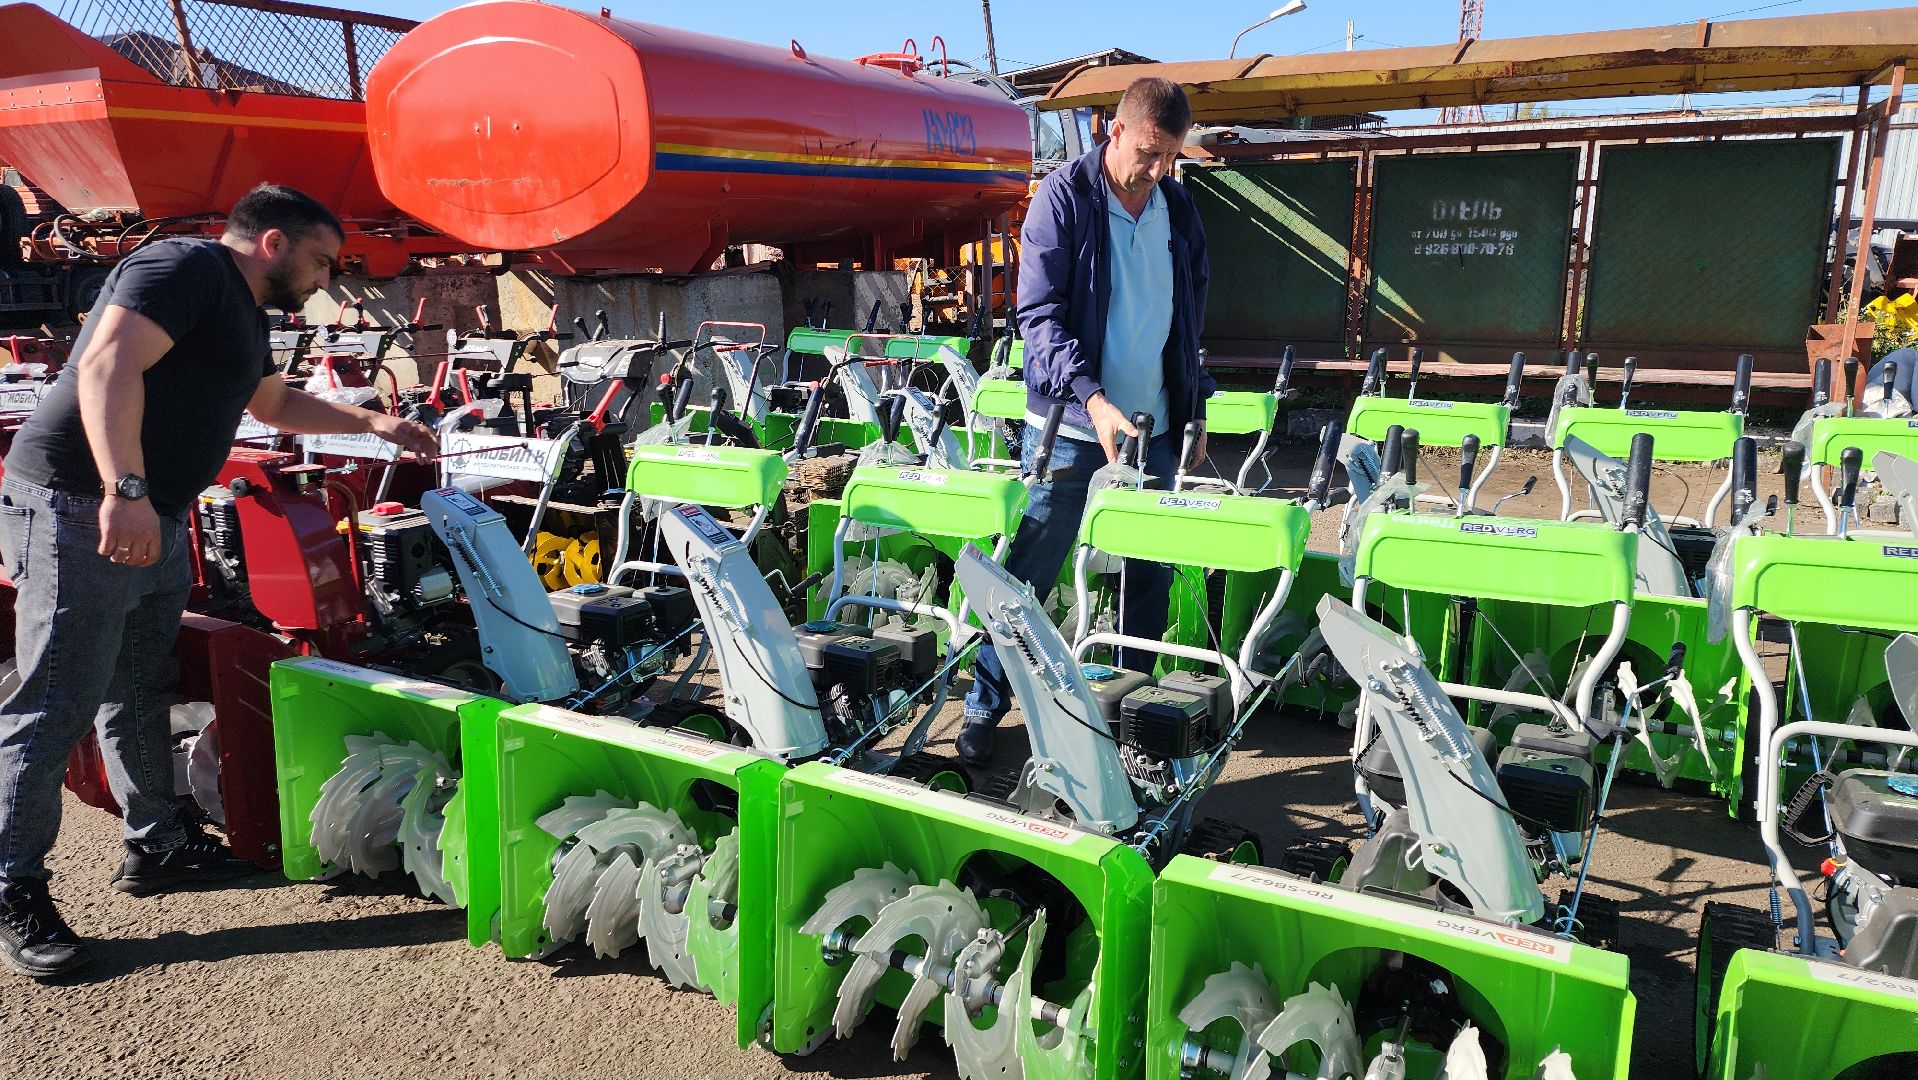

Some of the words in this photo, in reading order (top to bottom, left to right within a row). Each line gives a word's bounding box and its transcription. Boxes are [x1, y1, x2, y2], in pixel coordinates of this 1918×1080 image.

[1160, 496, 1221, 509] REDVERG
[1460, 523, 1537, 538] REDVERG
[1230, 873, 1335, 900] RD-SB62/7
[1436, 919, 1557, 955] REDVERG
